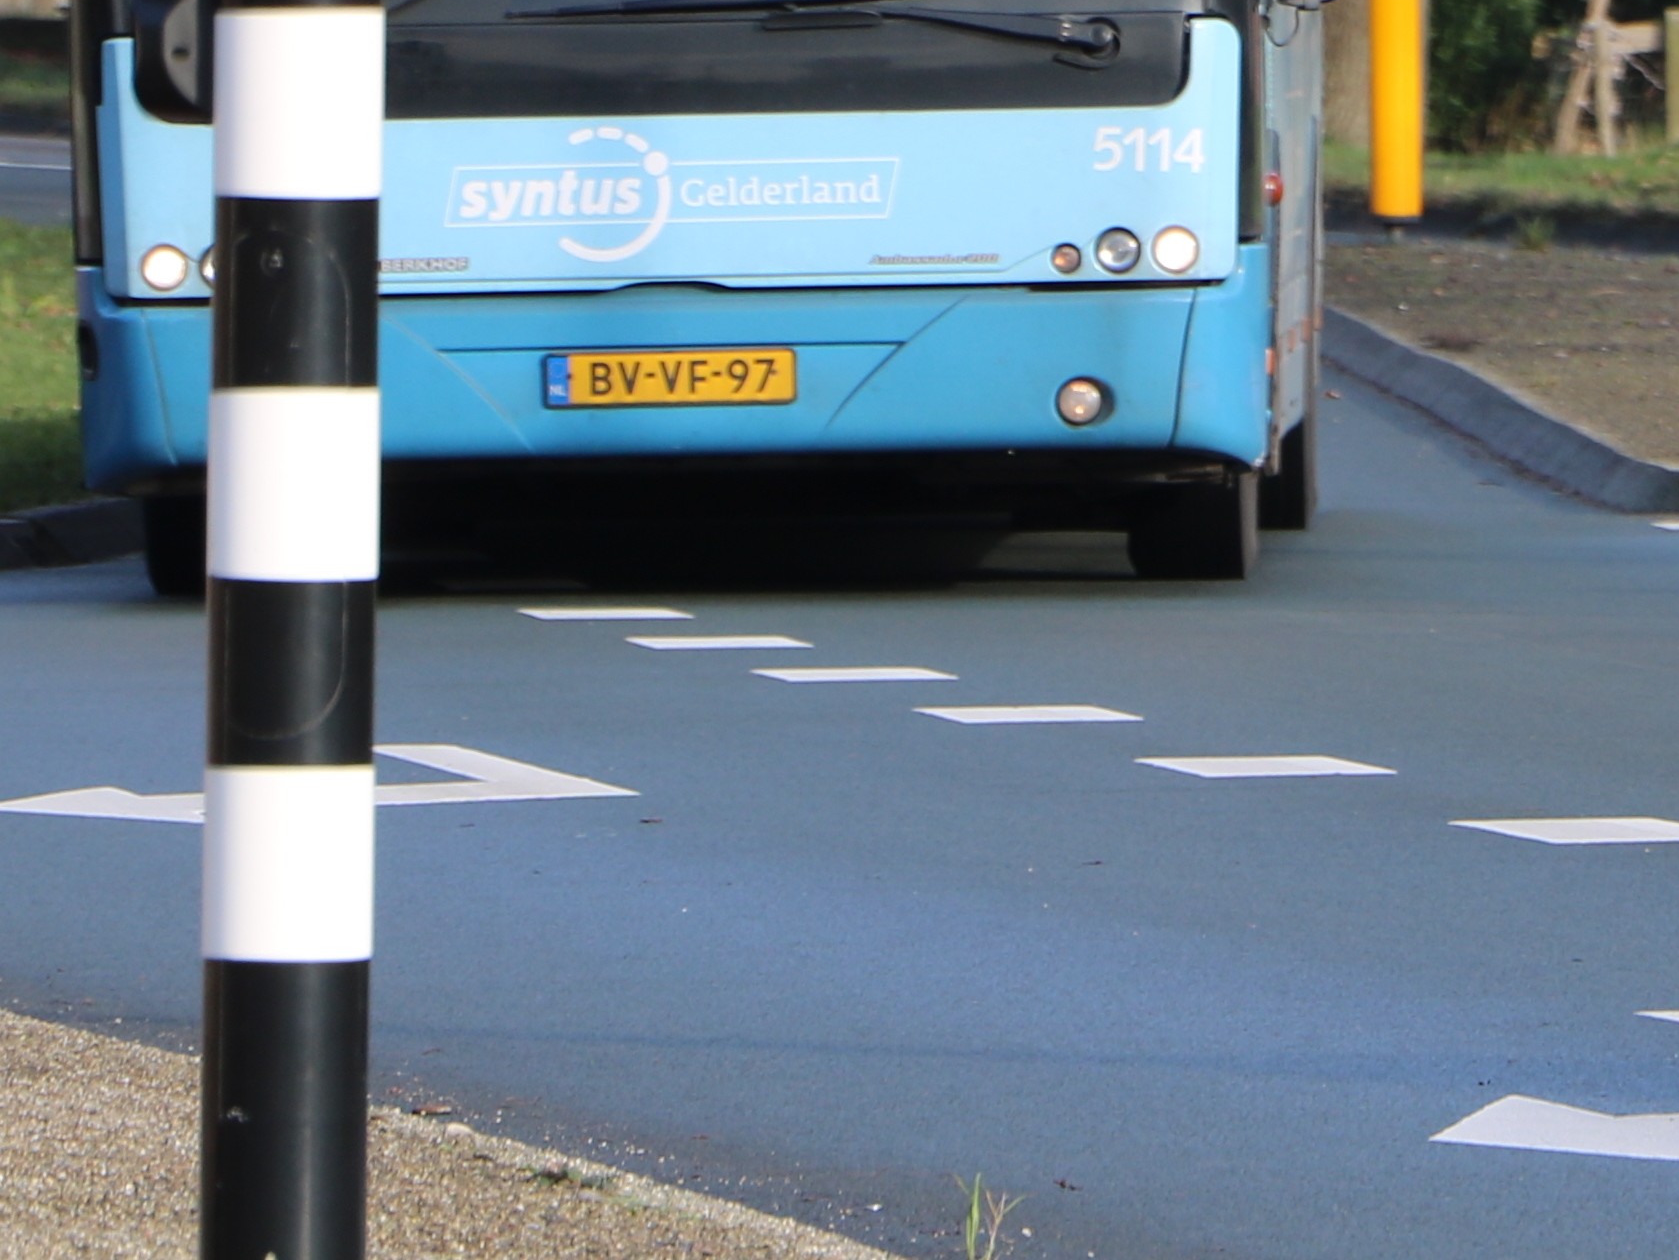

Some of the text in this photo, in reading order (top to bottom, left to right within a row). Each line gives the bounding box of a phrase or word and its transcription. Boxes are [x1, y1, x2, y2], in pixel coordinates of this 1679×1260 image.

[1092, 126, 1206, 174] 5114
[459, 170, 882, 222] syntus Gelderland
[379, 256, 469, 273] BERKHOF
[548, 357, 776, 397] NL BV-VF-97
